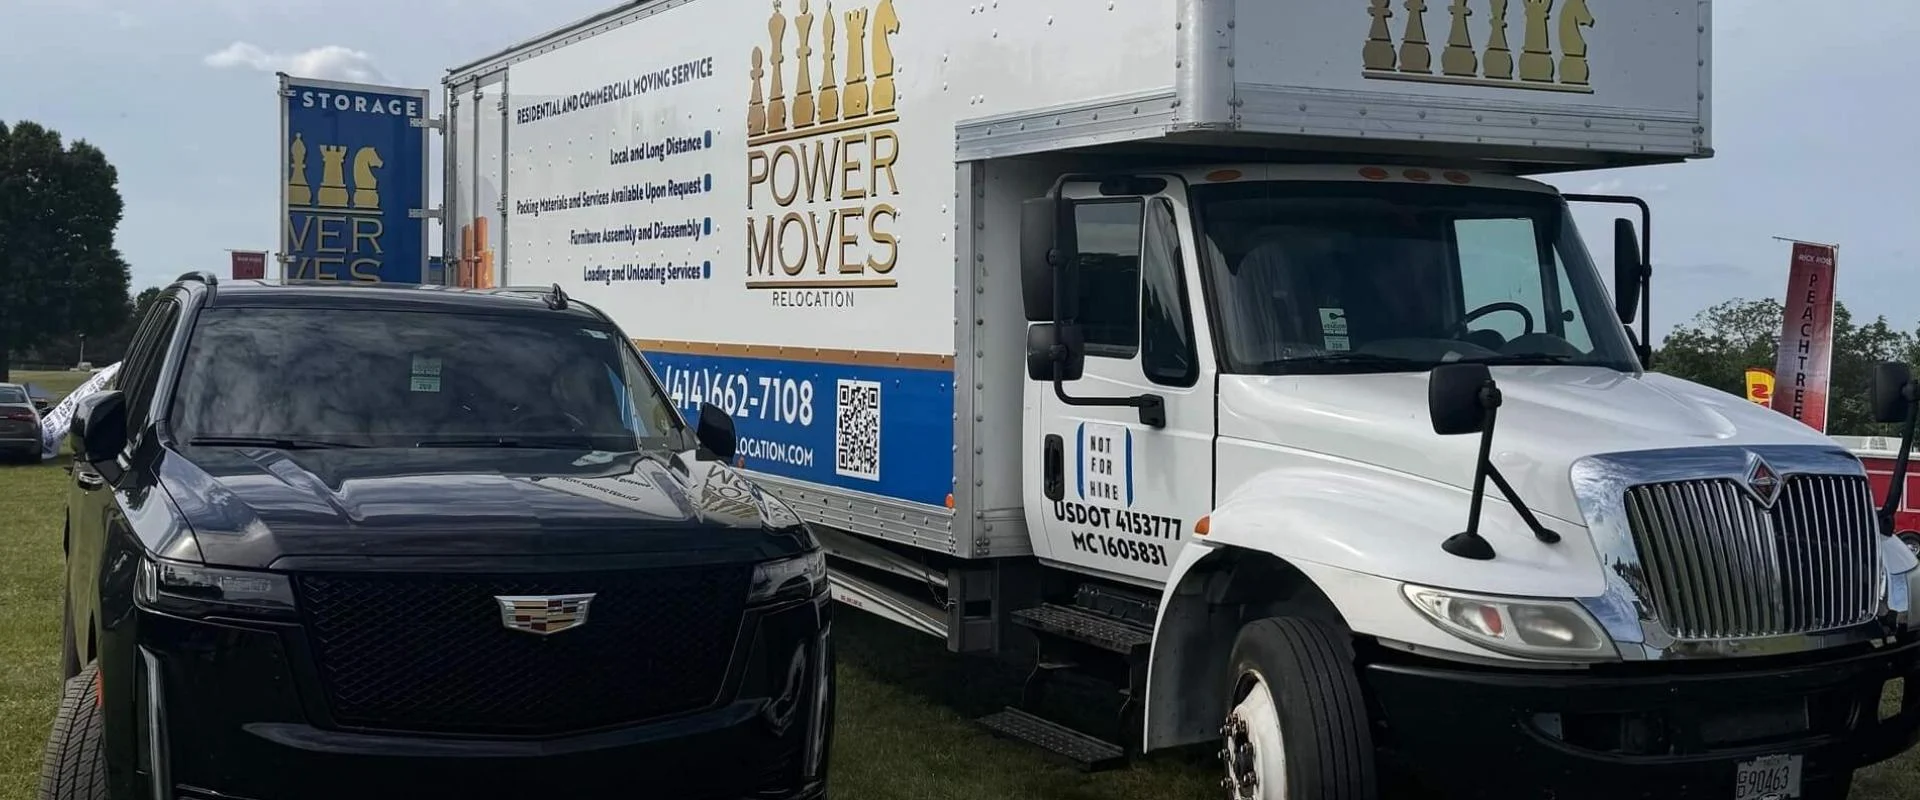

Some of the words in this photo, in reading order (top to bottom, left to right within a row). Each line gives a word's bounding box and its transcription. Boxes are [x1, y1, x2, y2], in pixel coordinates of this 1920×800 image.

[303, 91, 417, 117] STORAGE
[517, 101, 561, 125] RESIDENTIAL
[562, 95, 578, 114] AND
[579, 80, 633, 109] COMMERCIAL
[633, 69, 670, 96] MOVING
[672, 56, 713, 86] SERVICE
[610, 143, 629, 165] Local
[630, 143, 645, 161] and
[647, 140, 665, 162] Long
[666, 136, 702, 156] Distance
[747, 128, 900, 210] POWER
[516, 200, 539, 217] Packing
[539, 196, 568, 213] Materials
[569, 194, 581, 209] and
[582, 191, 610, 207] Services
[610, 184, 644, 205] Available
[645, 182, 666, 204] Upon
[668, 176, 701, 200] Request
[570, 228, 601, 246] Furniture
[602, 223, 637, 245] Assembly
[638, 222, 653, 240] and
[746, 203, 899, 277] MOVES
[584, 265, 610, 285] Loading
[612, 265, 626, 281] and
[626, 262, 666, 285] Unloading
[667, 261, 701, 280] Services
[772, 290, 854, 307] RELOCATION
[1793, 273, 1818, 420] PEACHTREE
[665, 365, 813, 426] (414)662-7108
[1090, 435, 1111, 453] NOT
[1091, 457, 1112, 475] FOR
[1090, 481, 1118, 501] HIRE
[1053, 500, 1111, 529] USDOT
[1115, 509, 1182, 540] 4153777
[1071, 531, 1098, 554] MC
[1098, 535, 1168, 566] 1605831
[1748, 766, 1790, 794] 90463
